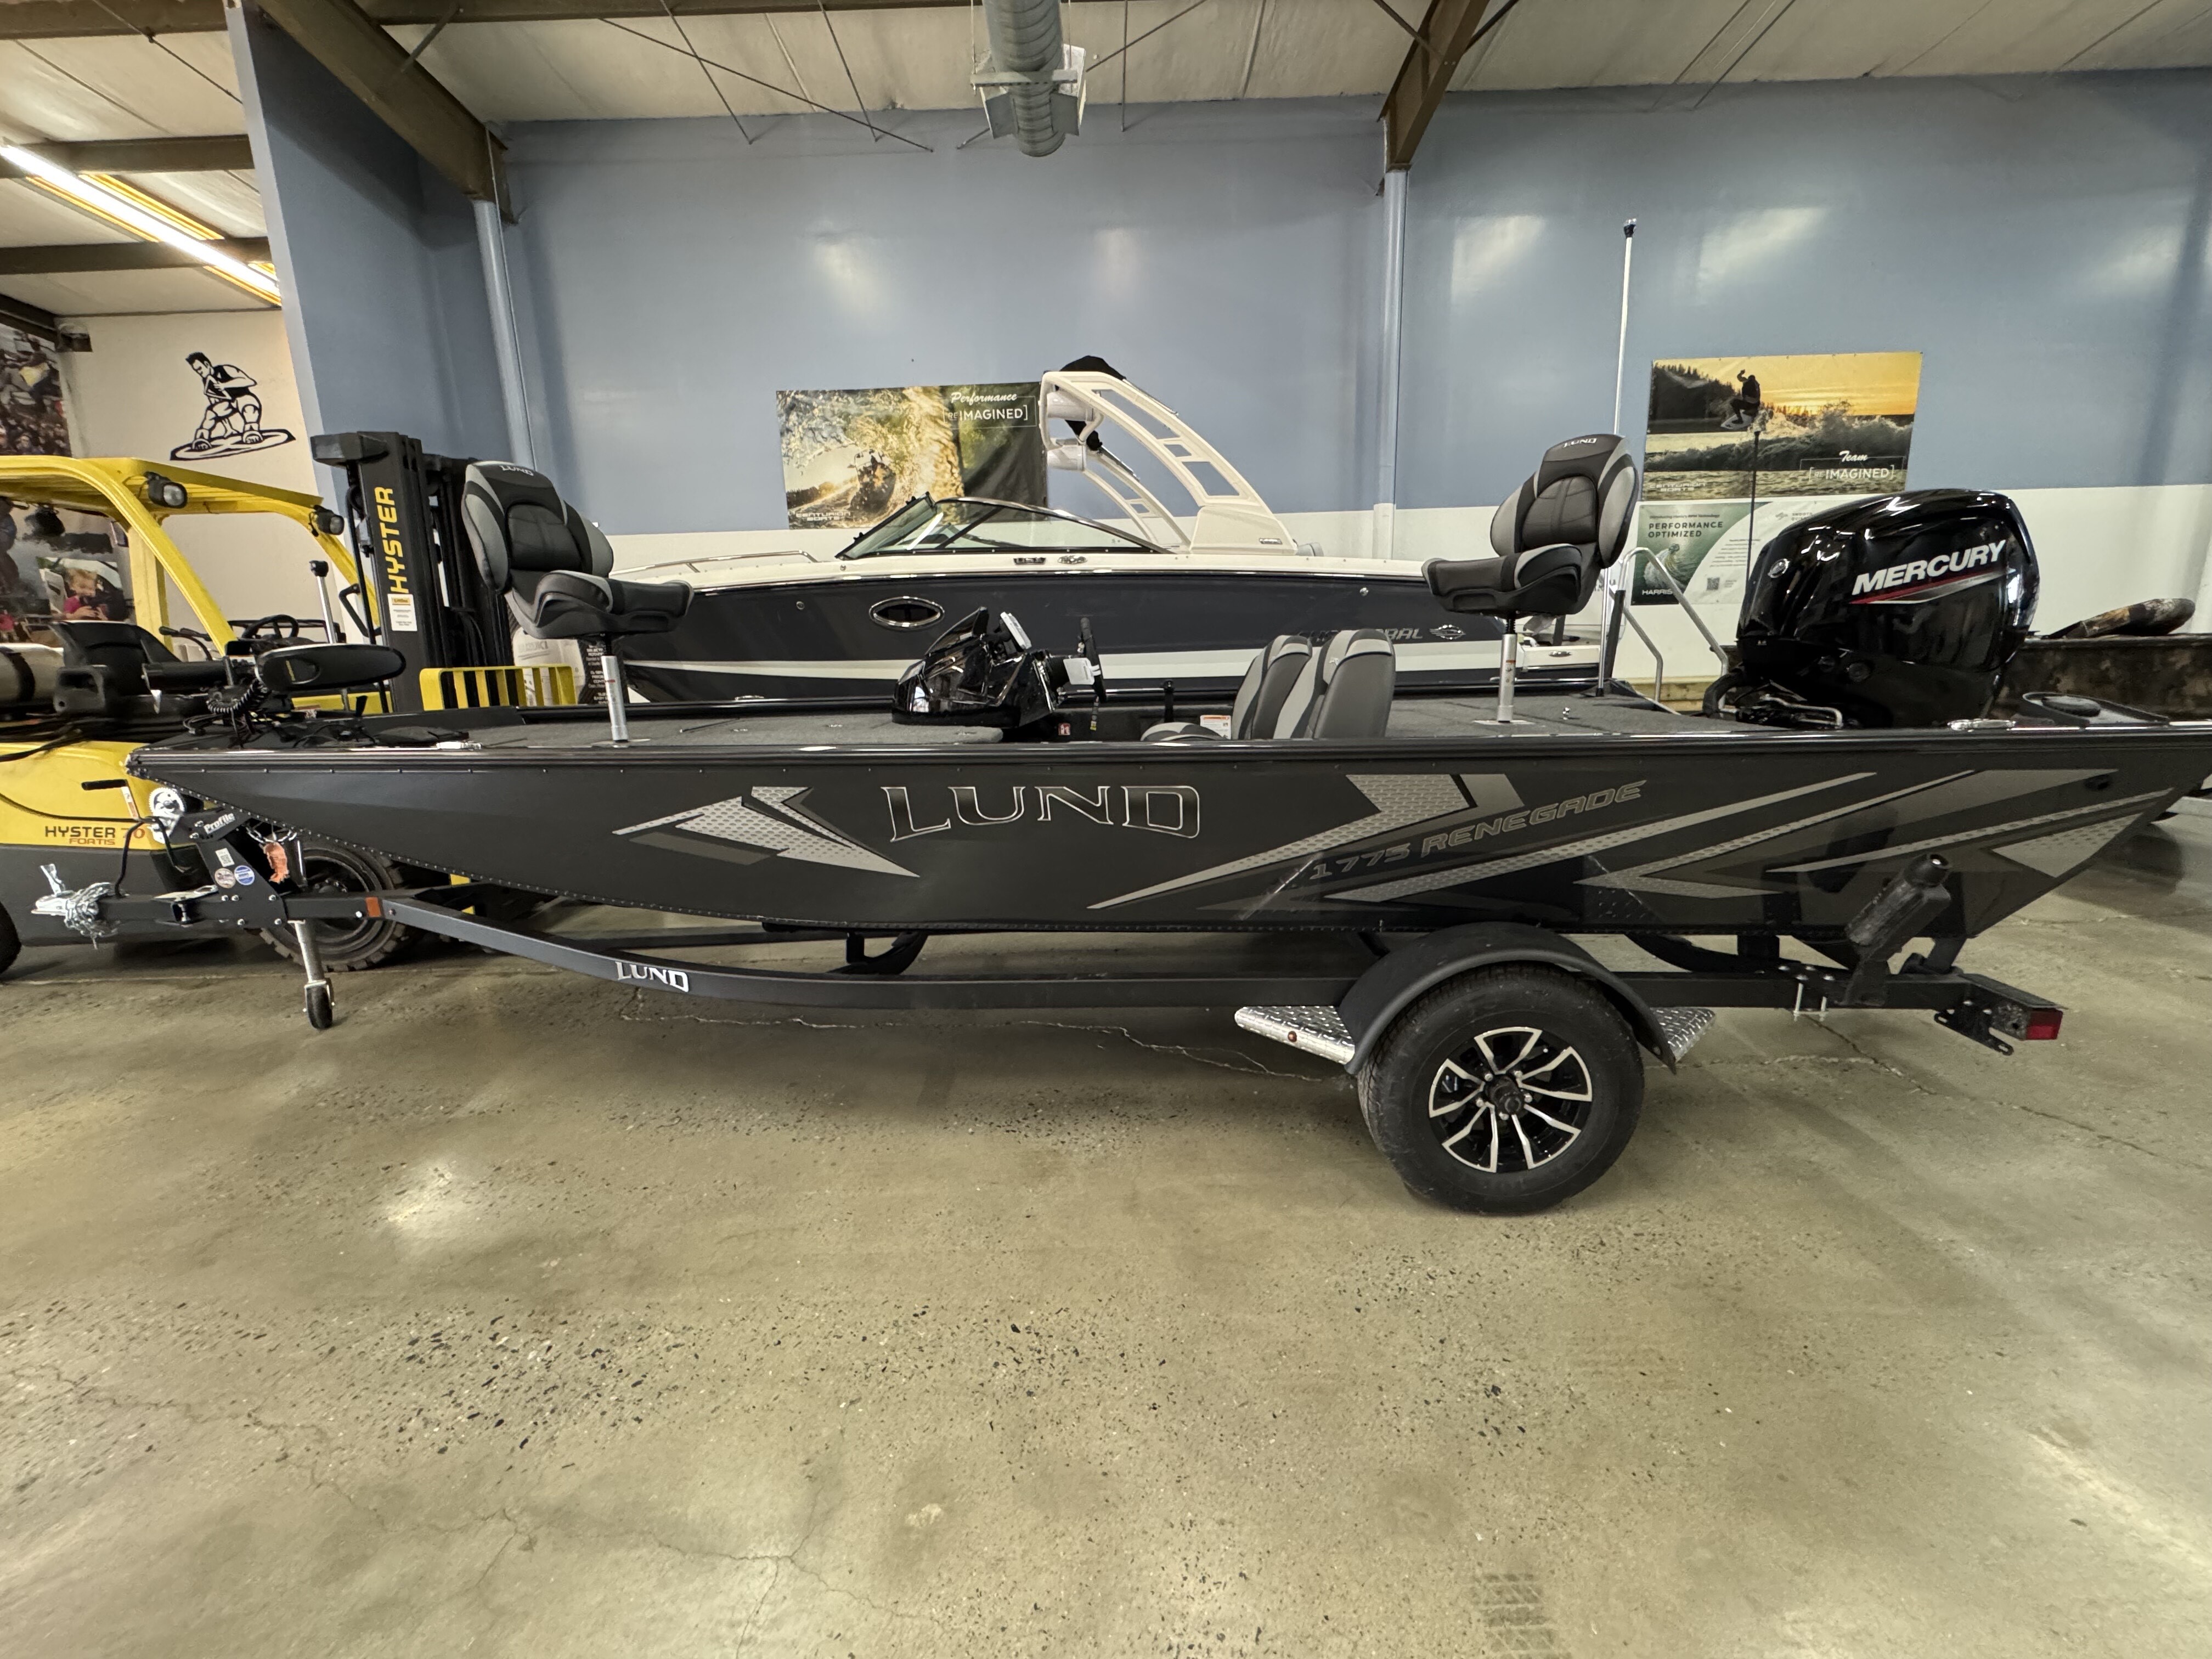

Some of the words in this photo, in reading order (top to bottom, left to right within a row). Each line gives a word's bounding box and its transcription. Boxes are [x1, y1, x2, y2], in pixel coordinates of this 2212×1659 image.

[951, 392, 1017, 405] Performance
[1839, 450, 1868, 462] Team
[499, 465, 534, 476] LUND
[1649, 521, 1723, 530] PERFORMANCE
[374, 486, 409, 594] HYSTER
[1852, 540, 2006, 596] MERCURY
[880, 786, 1200, 842] LUND
[45, 826, 116, 838] HYSTER
[1310, 843, 1411, 879] 1775
[1420, 780, 1647, 858] RENEGADE
[614, 961, 690, 992] LUND
